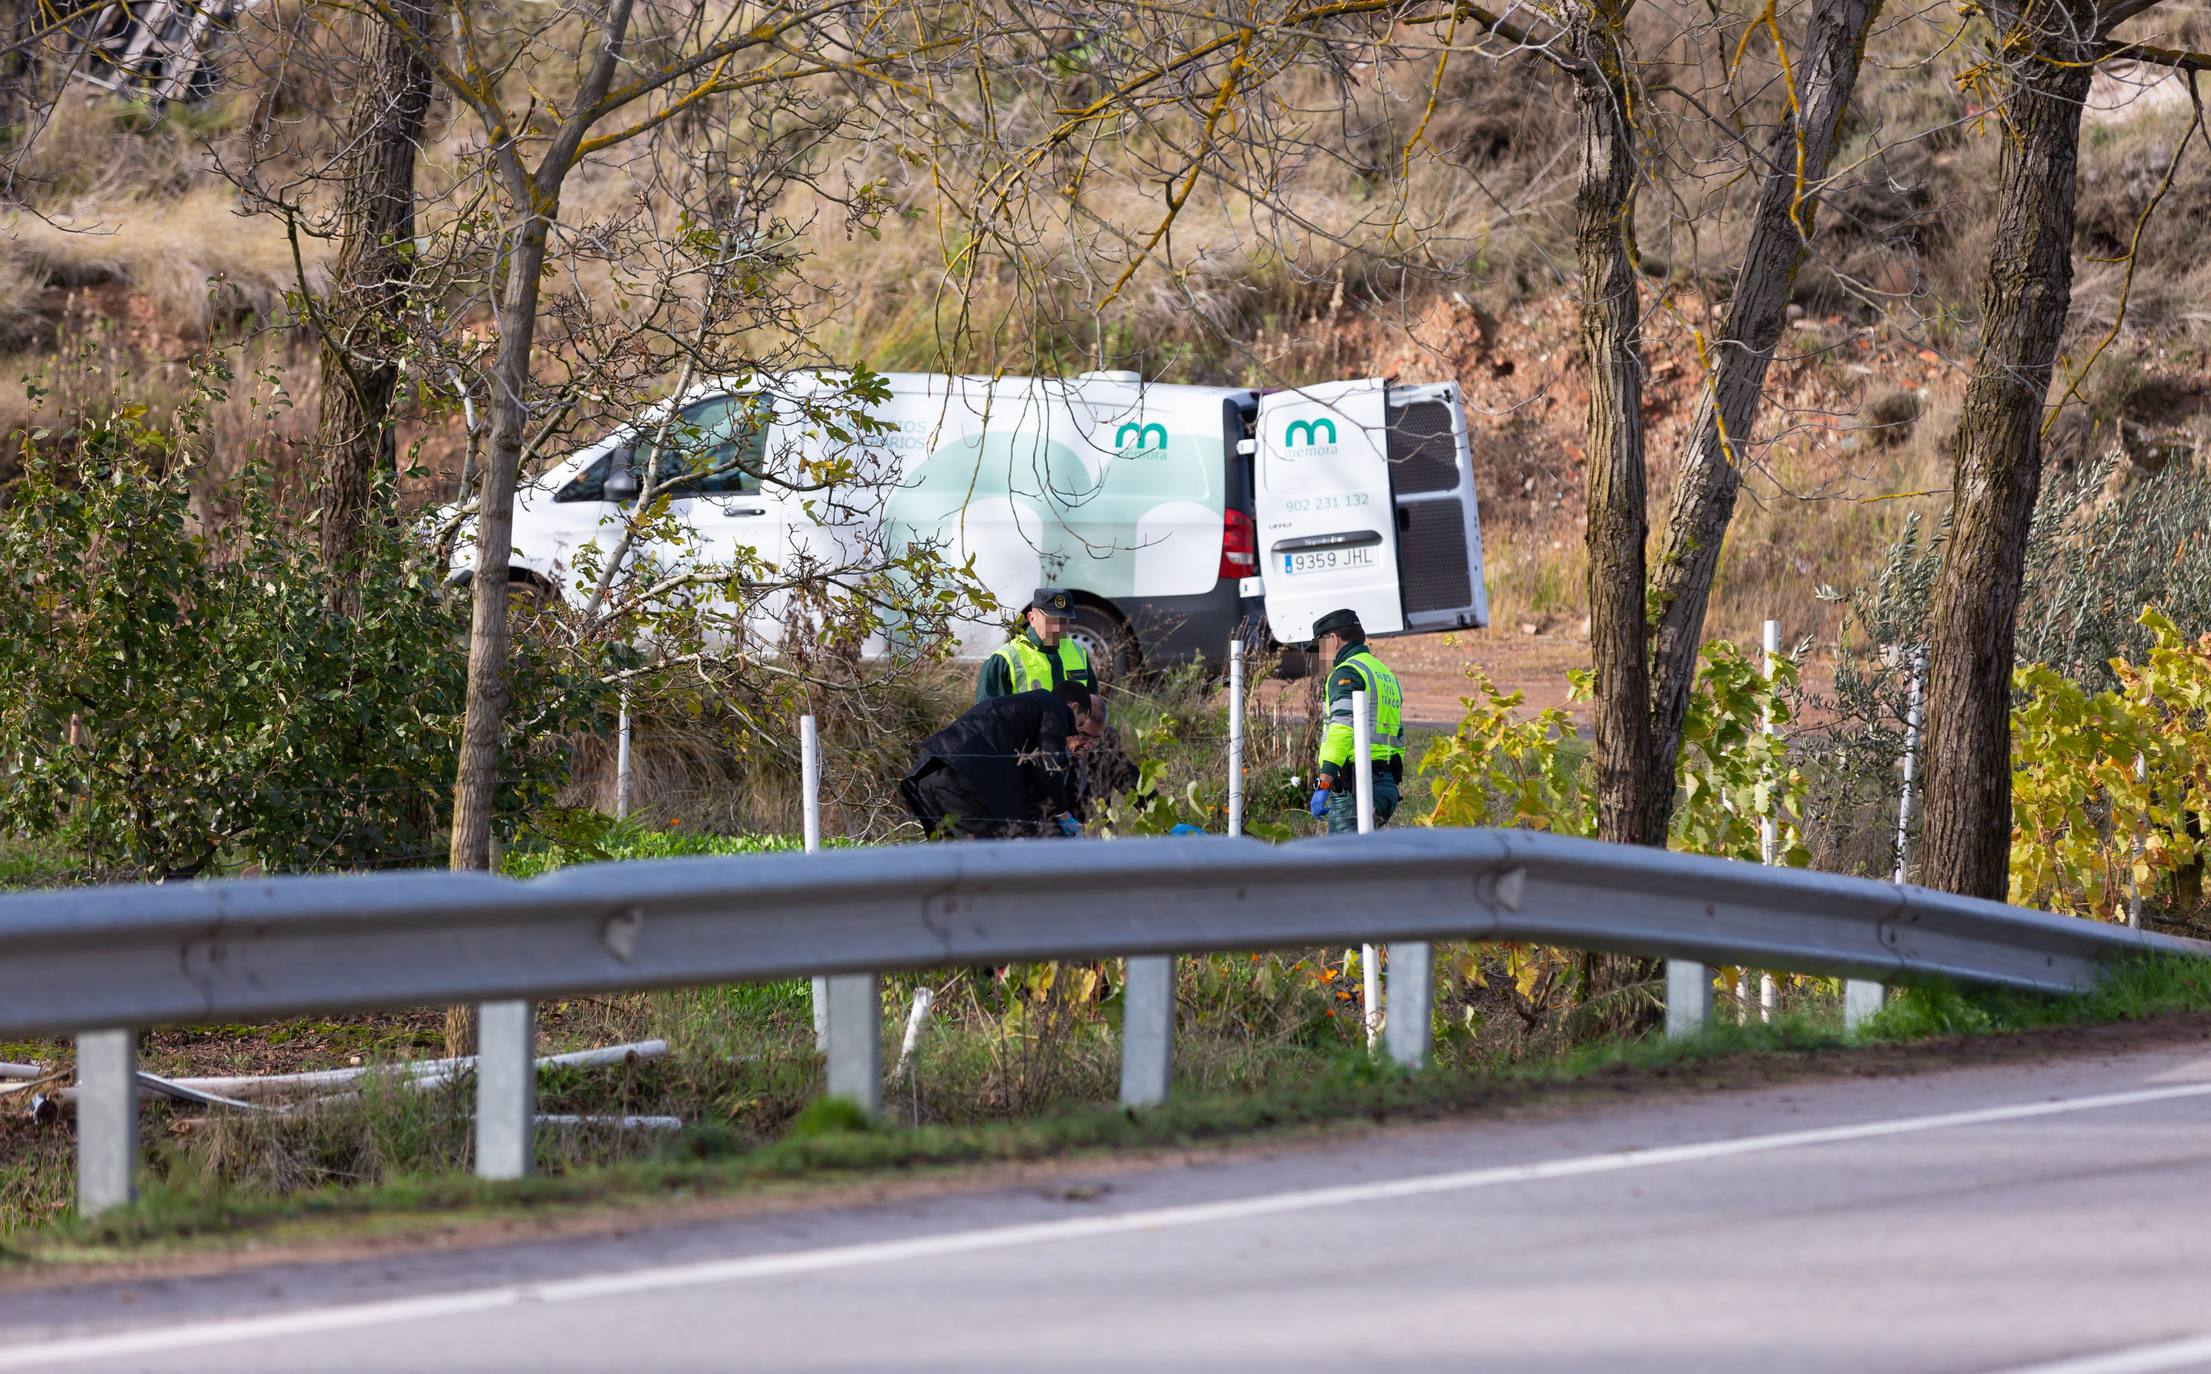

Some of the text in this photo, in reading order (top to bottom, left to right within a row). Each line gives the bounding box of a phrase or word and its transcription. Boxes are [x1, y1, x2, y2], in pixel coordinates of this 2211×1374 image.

[1115, 423, 1167, 449] m
[1286, 418, 1336, 447] m
[1286, 494, 1369, 512] 902 231 132
[1296, 548, 1373, 570] 9359 JHL
